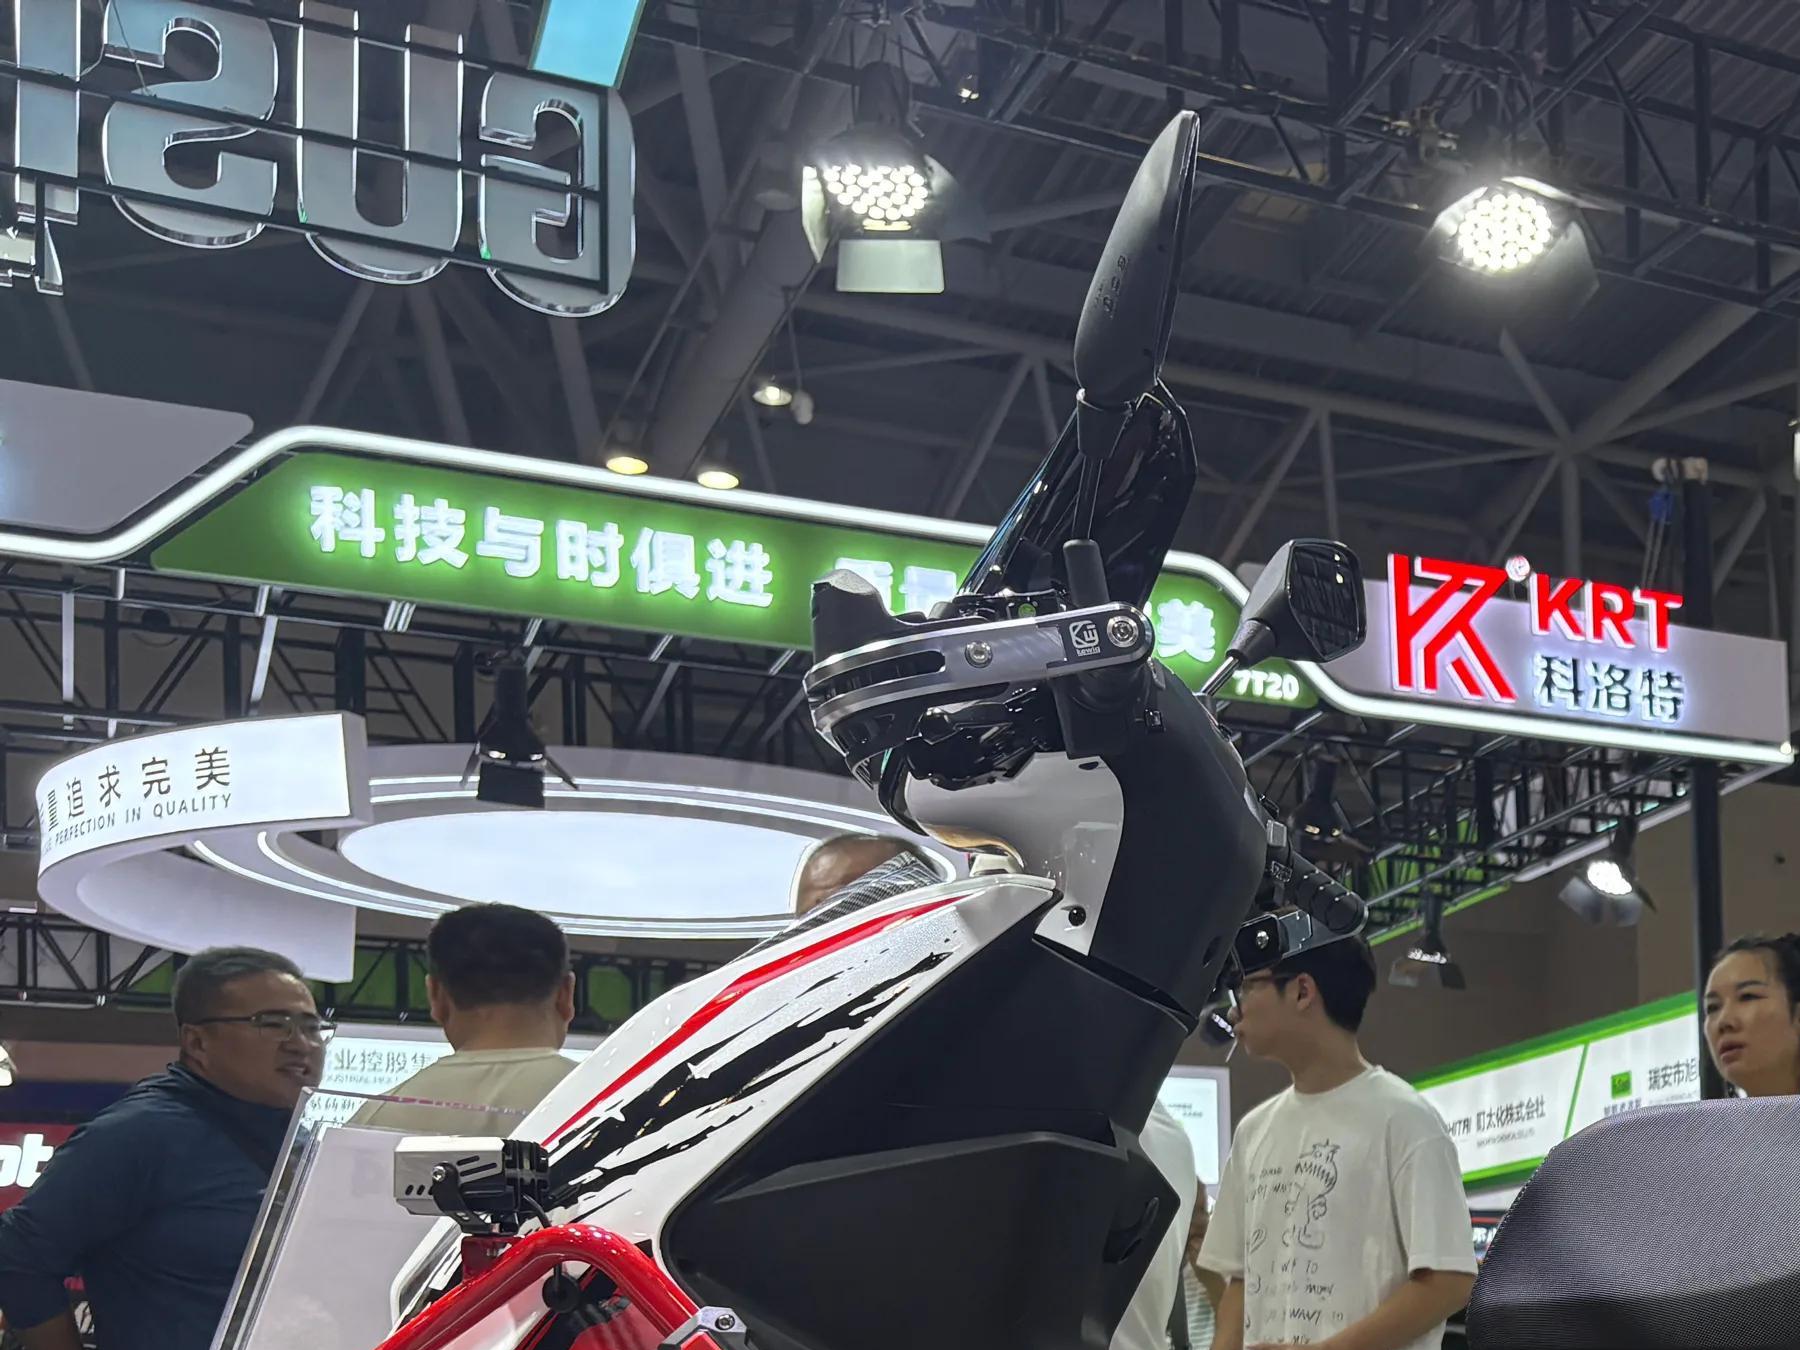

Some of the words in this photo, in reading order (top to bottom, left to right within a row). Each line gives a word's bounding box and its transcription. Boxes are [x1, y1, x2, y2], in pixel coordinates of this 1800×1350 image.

[309, 484, 775, 608] 科技与时俱进
[1529, 569, 1684, 653] KRT
[1231, 669, 1300, 701] 7T20
[1532, 652, 1686, 723] 科洛特
[153, 793, 232, 820] QUALITY
